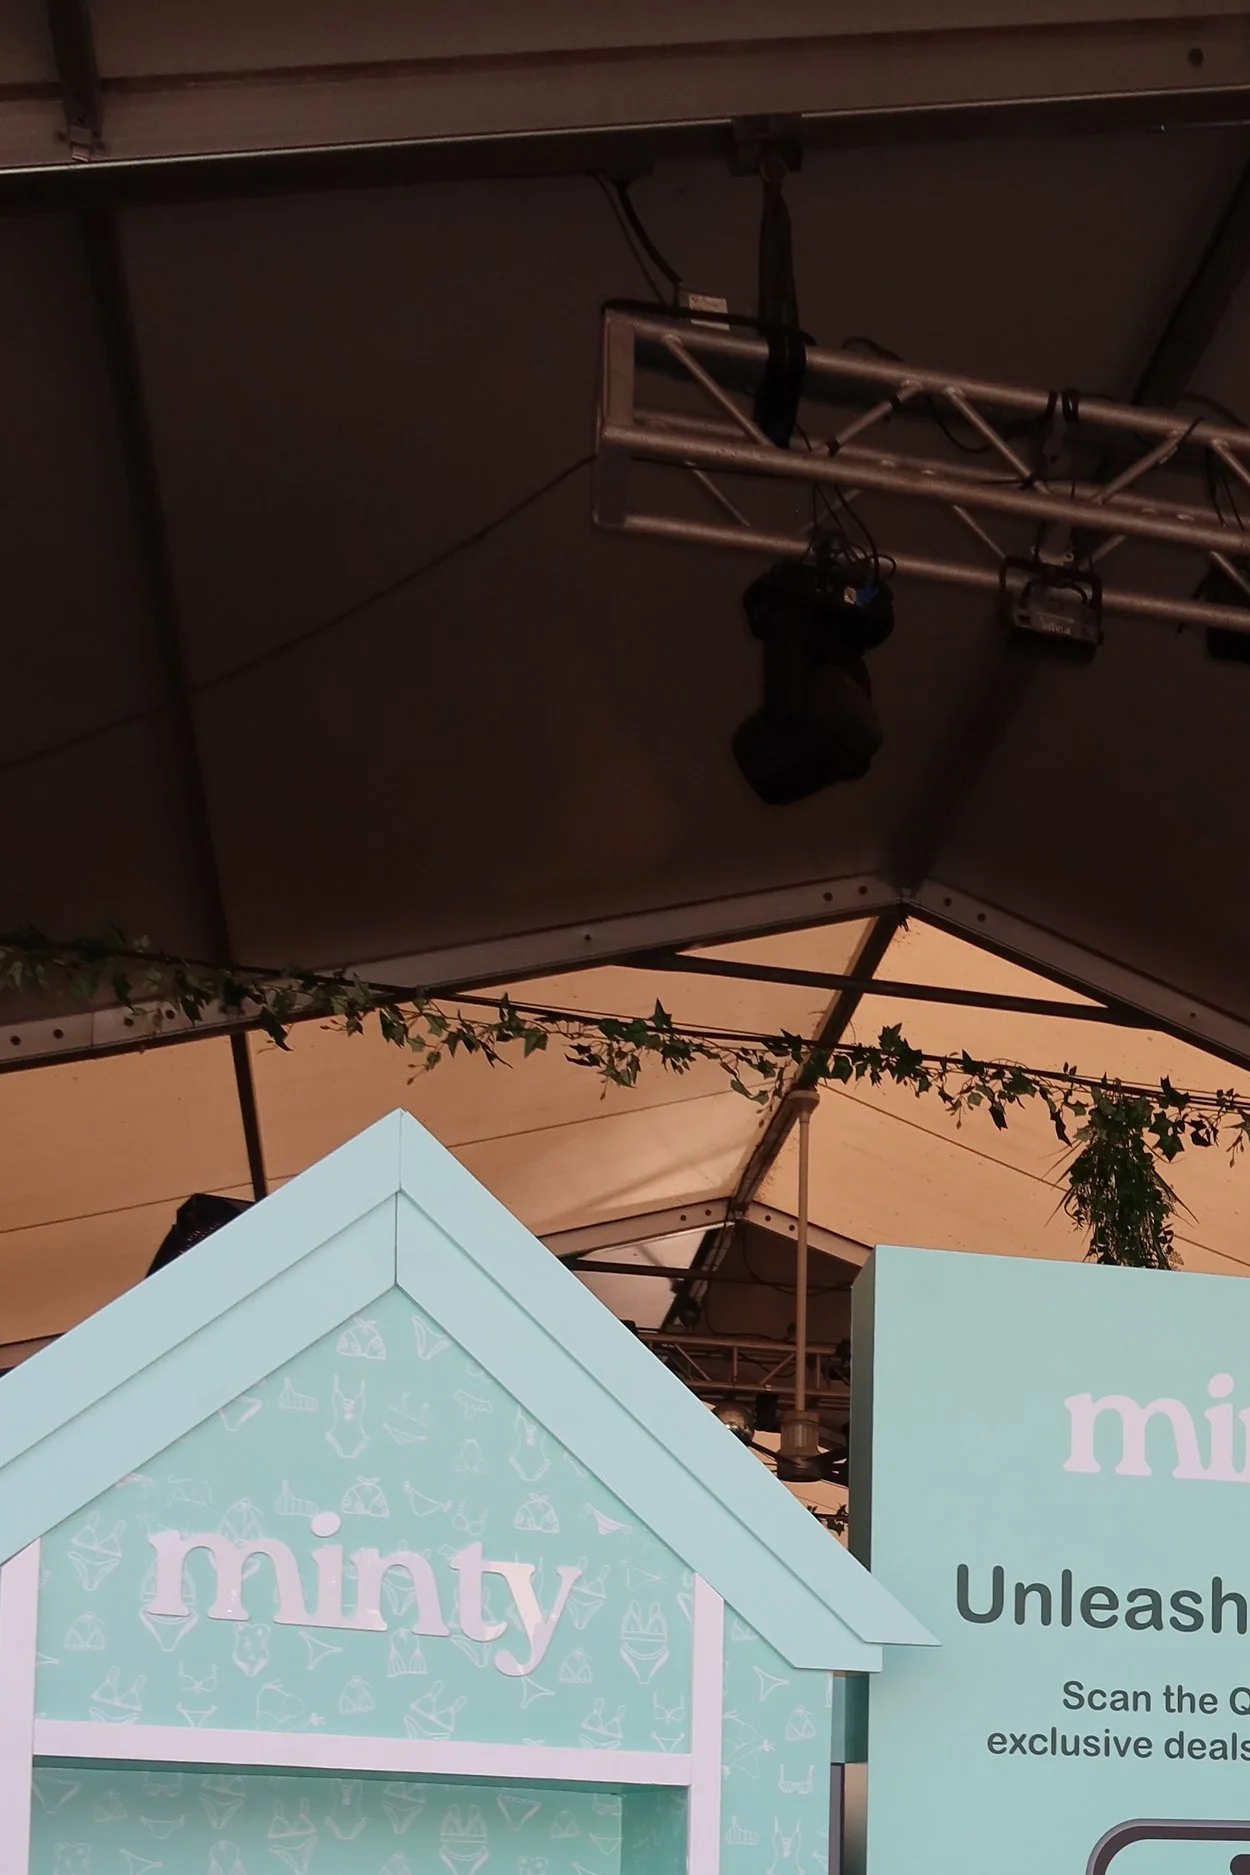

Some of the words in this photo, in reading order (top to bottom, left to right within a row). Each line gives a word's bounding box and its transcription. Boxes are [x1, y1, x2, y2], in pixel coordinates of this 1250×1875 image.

[148, 1511, 582, 1676] minty
[956, 1562, 1248, 1636] Unleash
[1062, 1680, 1152, 1713] Scan
[1162, 1684, 1218, 1716] the
[987, 1726, 1153, 1759] exclusive
